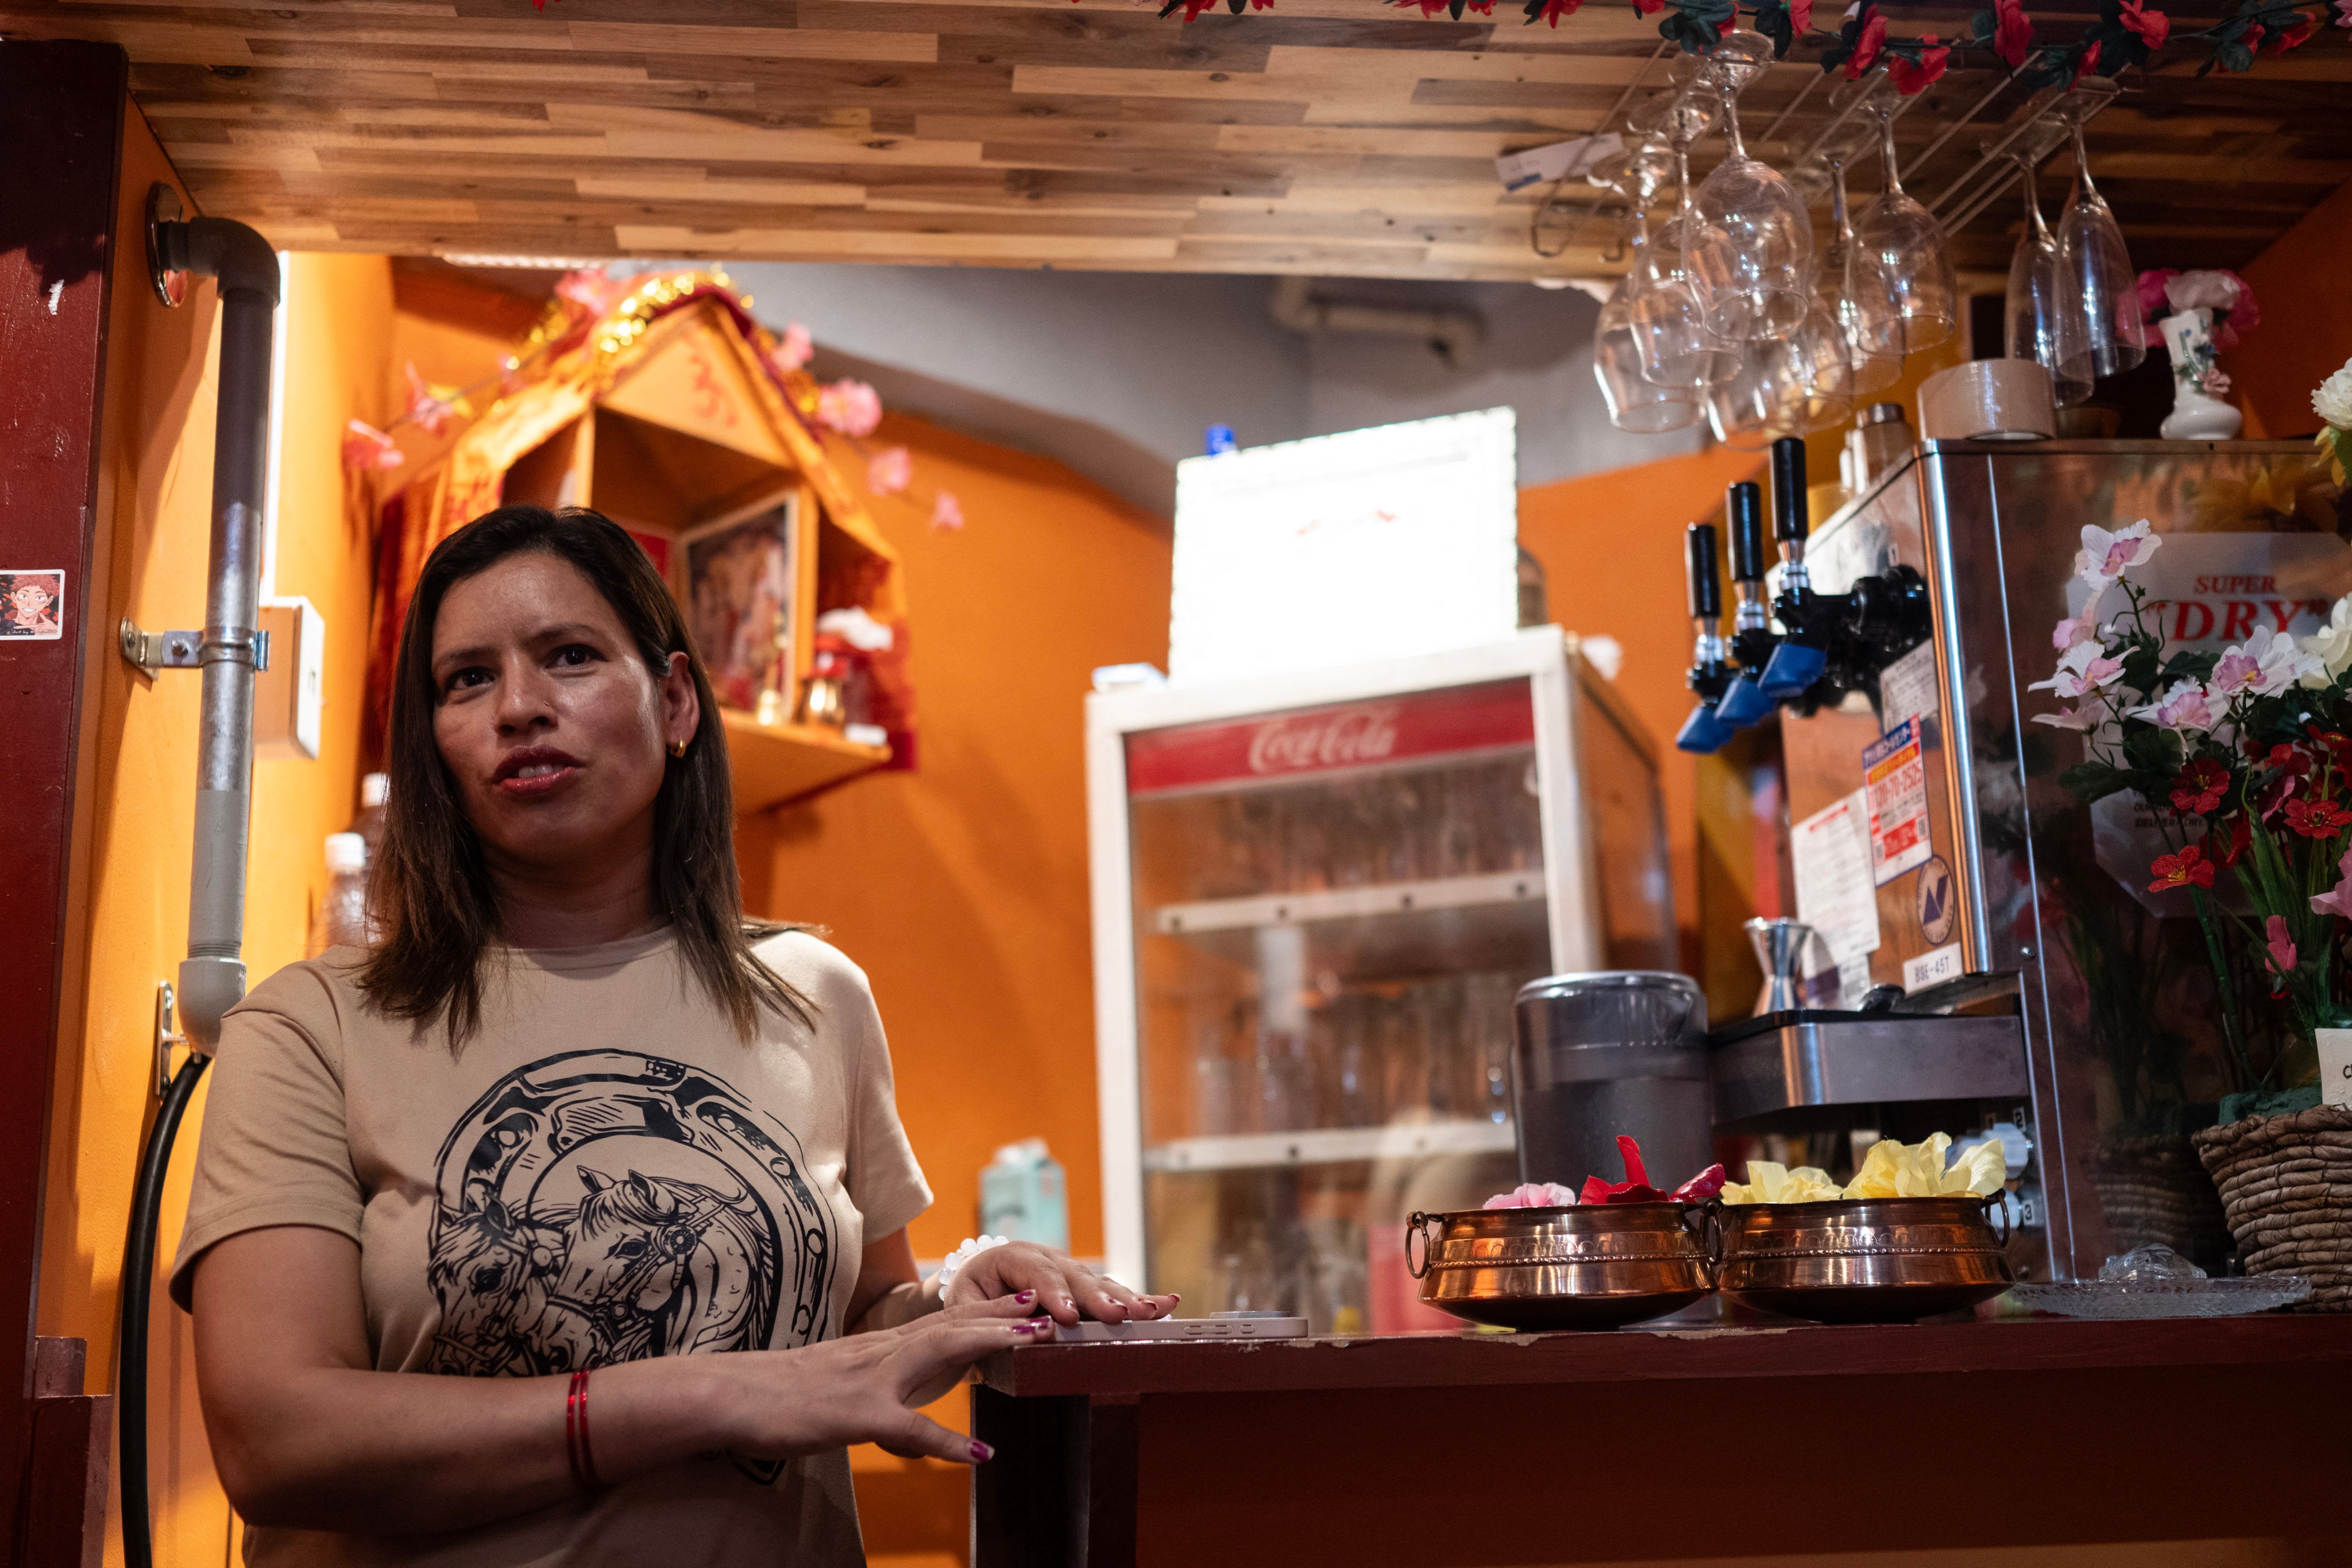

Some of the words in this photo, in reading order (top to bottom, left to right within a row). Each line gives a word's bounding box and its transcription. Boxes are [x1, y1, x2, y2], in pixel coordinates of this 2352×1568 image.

[2193, 575, 2277, 594] SUPER
[1914, 955, 1949, 983] BSE-45T
[2015, 1111, 2022, 1127] 2
[2025, 1204, 2032, 1221] 3
